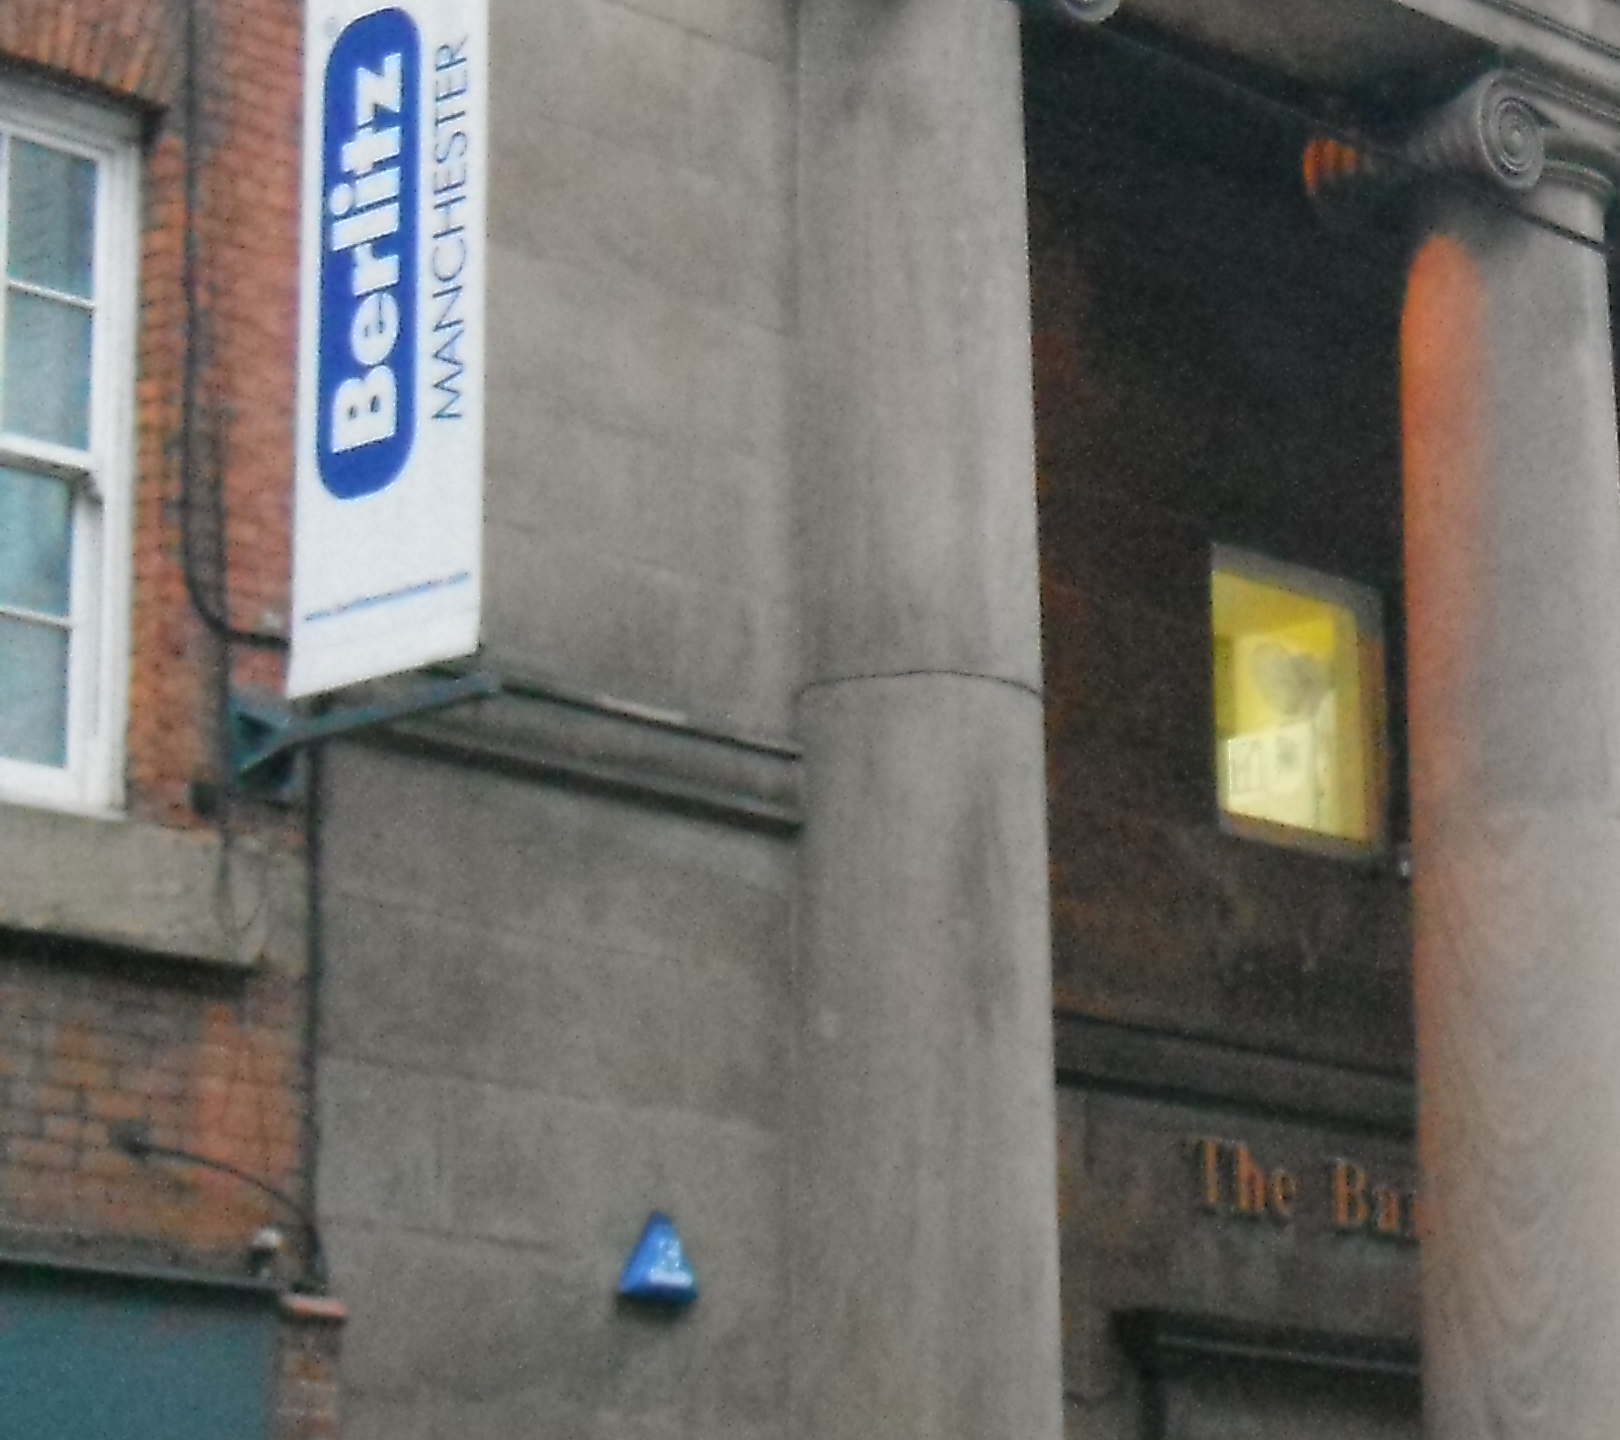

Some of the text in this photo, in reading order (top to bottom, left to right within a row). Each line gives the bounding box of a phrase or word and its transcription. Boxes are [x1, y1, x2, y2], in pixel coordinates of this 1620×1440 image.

[329, 52, 403, 453] Berlitz
[430, 34, 470, 422] MANCHESTER
[1186, 1134, 1304, 1218] The
